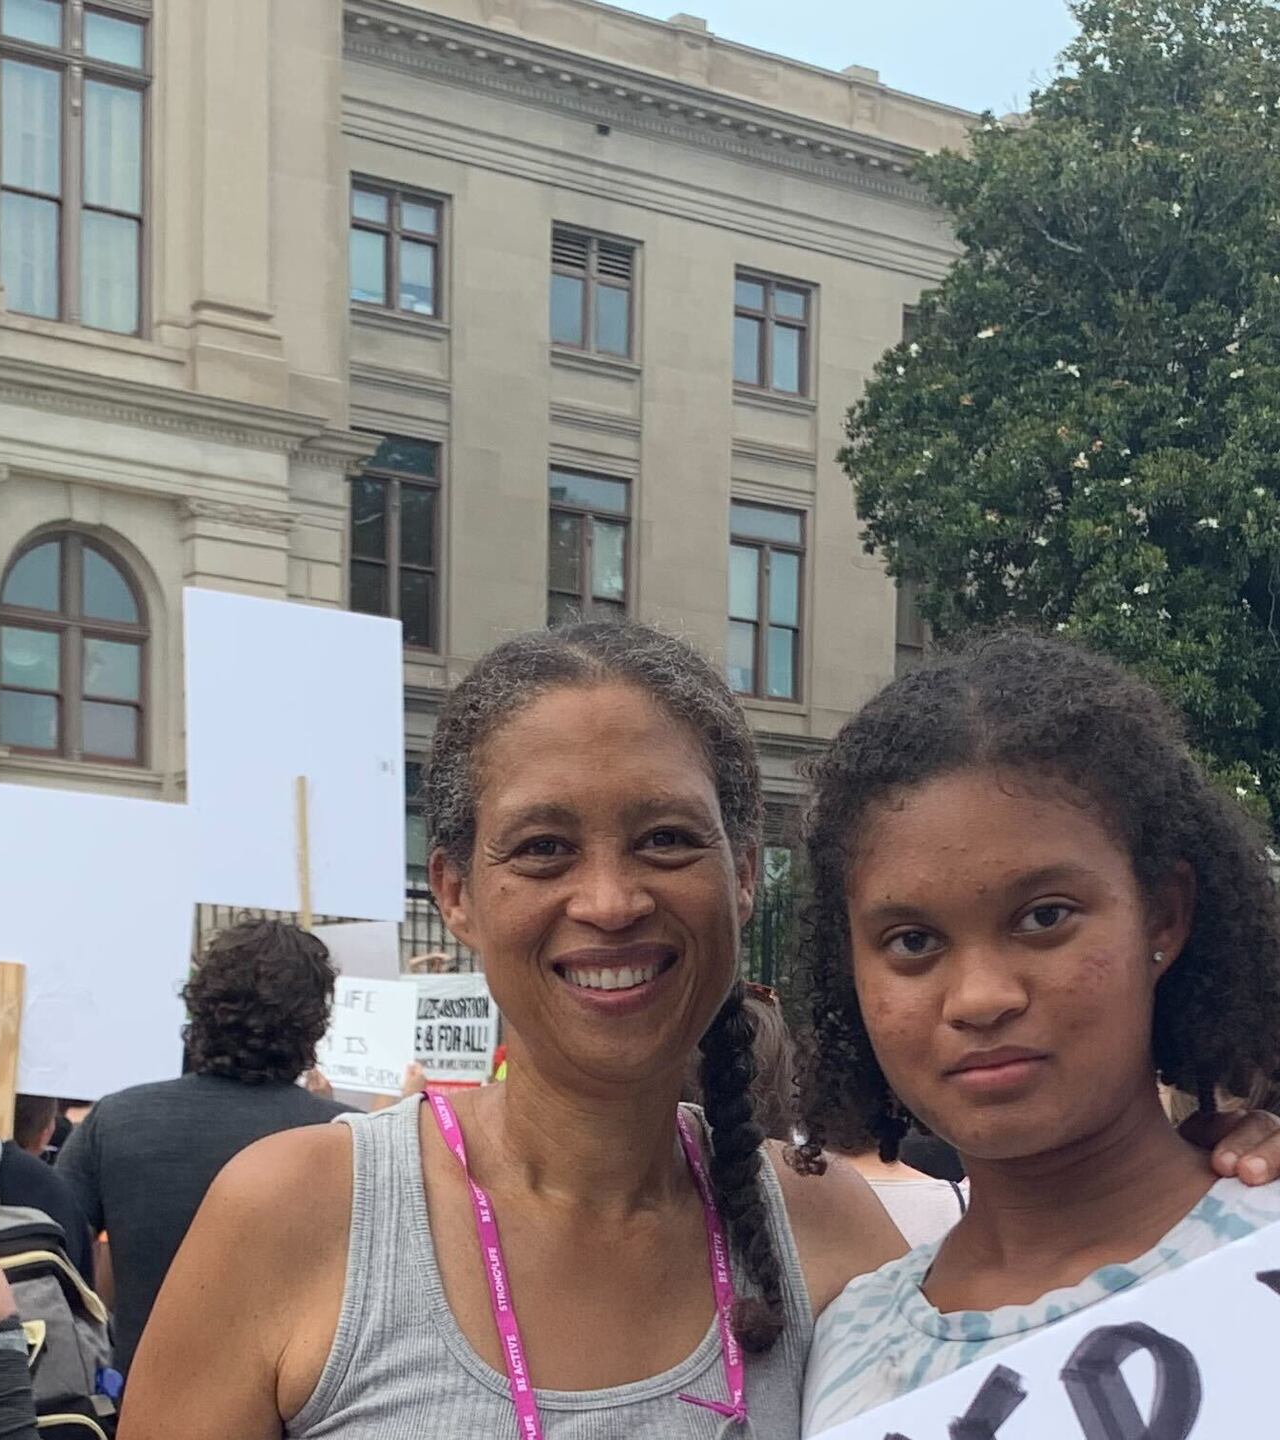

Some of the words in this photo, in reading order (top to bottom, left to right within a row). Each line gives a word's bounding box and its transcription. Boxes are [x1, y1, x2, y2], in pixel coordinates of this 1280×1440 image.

[437, 1024, 461, 1053] FOR
[506, 1333, 524, 1377] ACTIVE
[515, 1377, 528, 1392] BE
